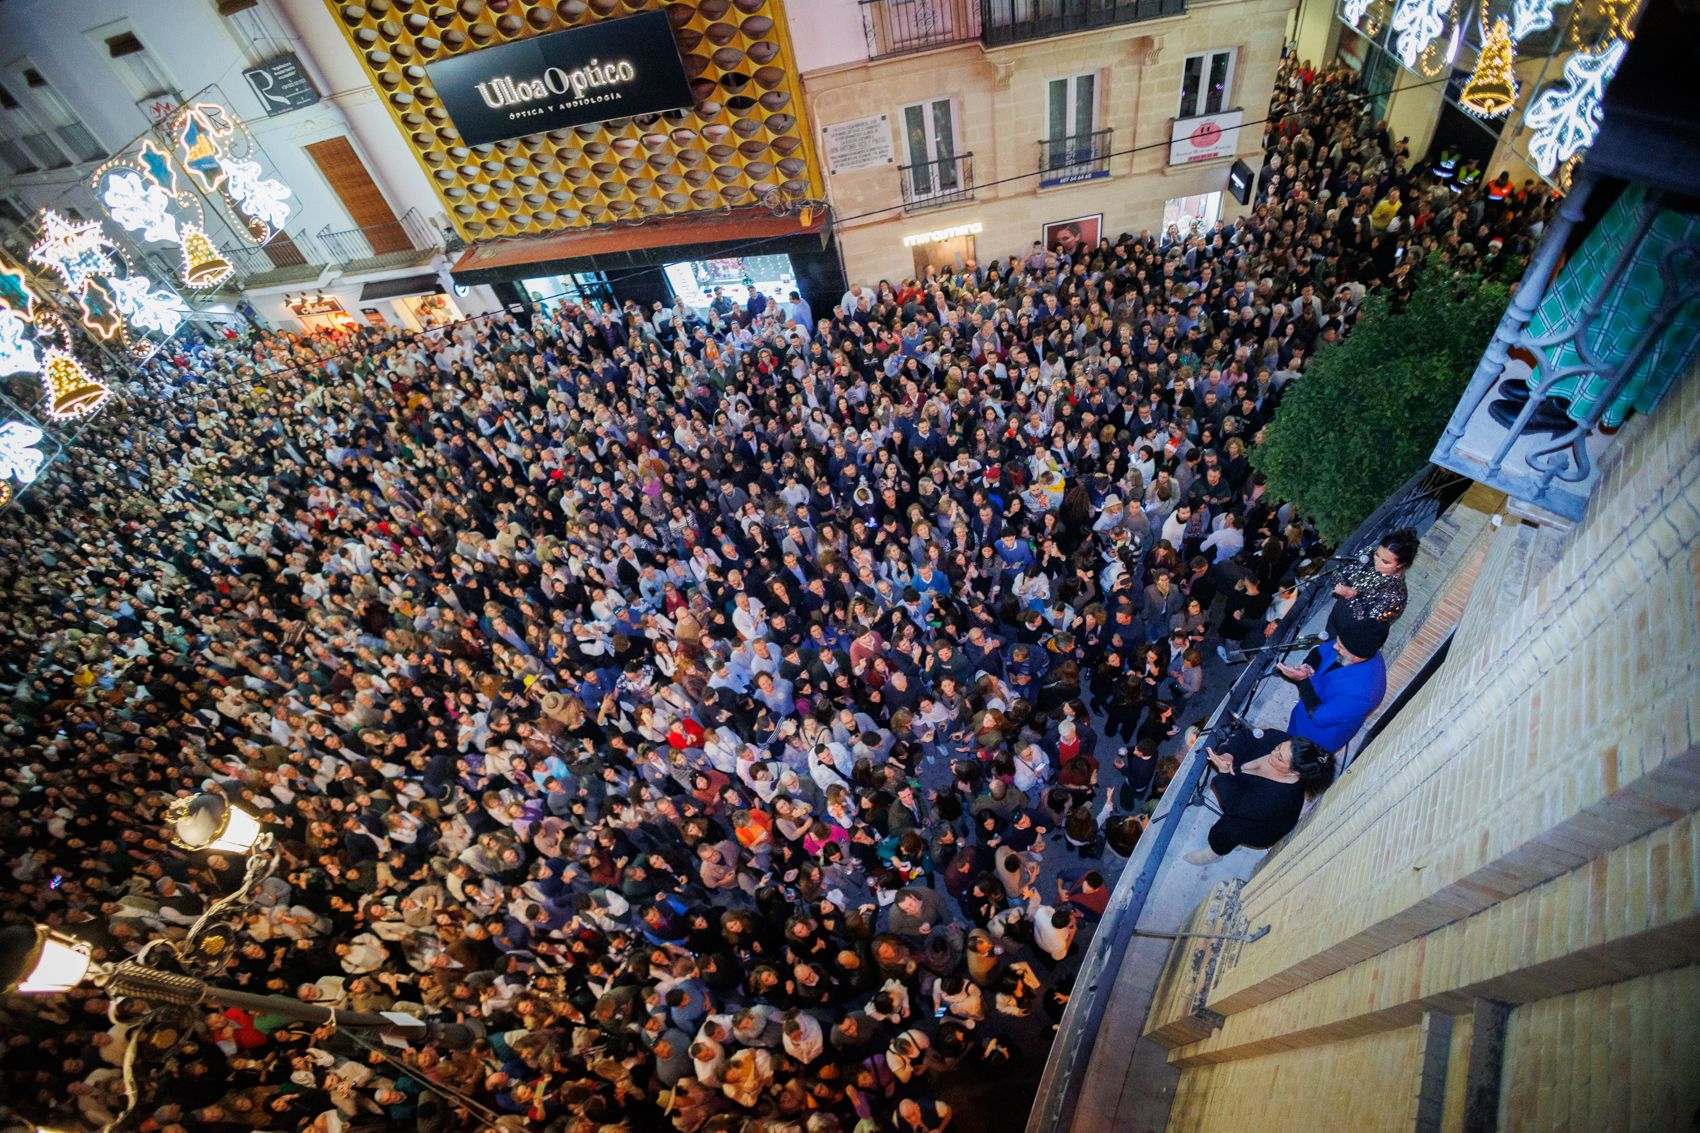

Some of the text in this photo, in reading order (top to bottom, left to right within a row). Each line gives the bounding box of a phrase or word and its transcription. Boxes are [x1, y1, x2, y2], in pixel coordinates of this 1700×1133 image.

[244, 70, 291, 111] R
[509, 92, 622, 121] ÓPTICA Y AUDIOLOGÍA
